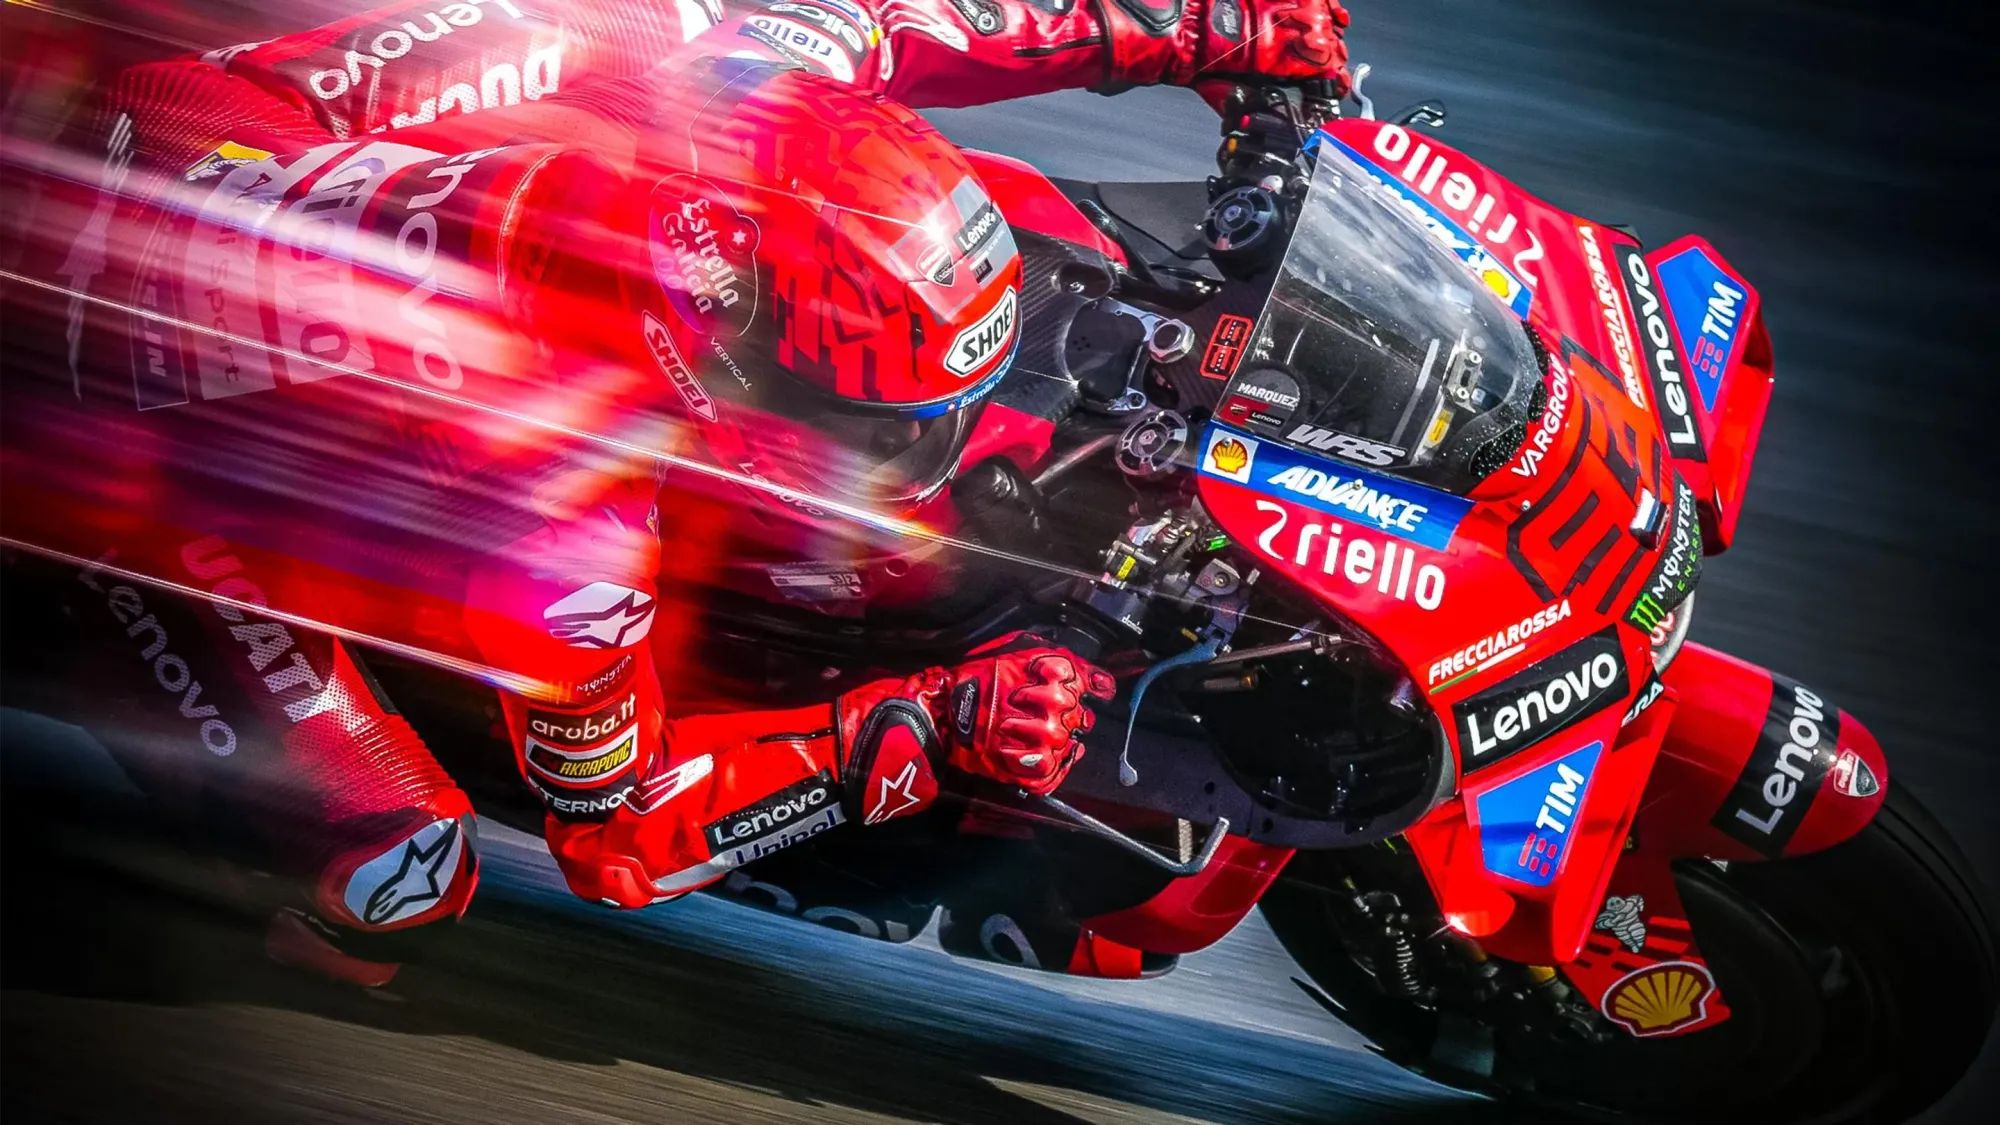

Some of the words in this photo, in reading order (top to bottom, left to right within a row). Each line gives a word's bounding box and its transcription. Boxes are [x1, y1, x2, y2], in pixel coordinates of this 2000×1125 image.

[755, 18, 833, 57] riello
[368, 45, 561, 135] DUC
[1373, 123, 1518, 244] riello
[679, 197, 740, 309] Estrella
[961, 297, 1014, 367] SHOEI
[1627, 252, 1698, 447] Lenovo
[1702, 280, 1744, 342] TIM
[647, 327, 710, 409] SHOEI
[710, 336, 753, 393] VERTICAL
[1237, 382, 1299, 408] MARQUEZ
[1251, 411, 1282, 426] Lenovo
[1285, 423, 1406, 466] WRS
[1510, 353, 1571, 479] VARGROU
[1267, 465, 1429, 532] ADVANCE
[1295, 522, 1446, 611] riello
[1428, 600, 1572, 685] FRECCIAROSSA
[1467, 652, 1620, 757] Lenovo
[1736, 685, 1824, 835] Lenovo
[714, 787, 827, 845] Lenovo
[1536, 763, 1586, 835] TIM
